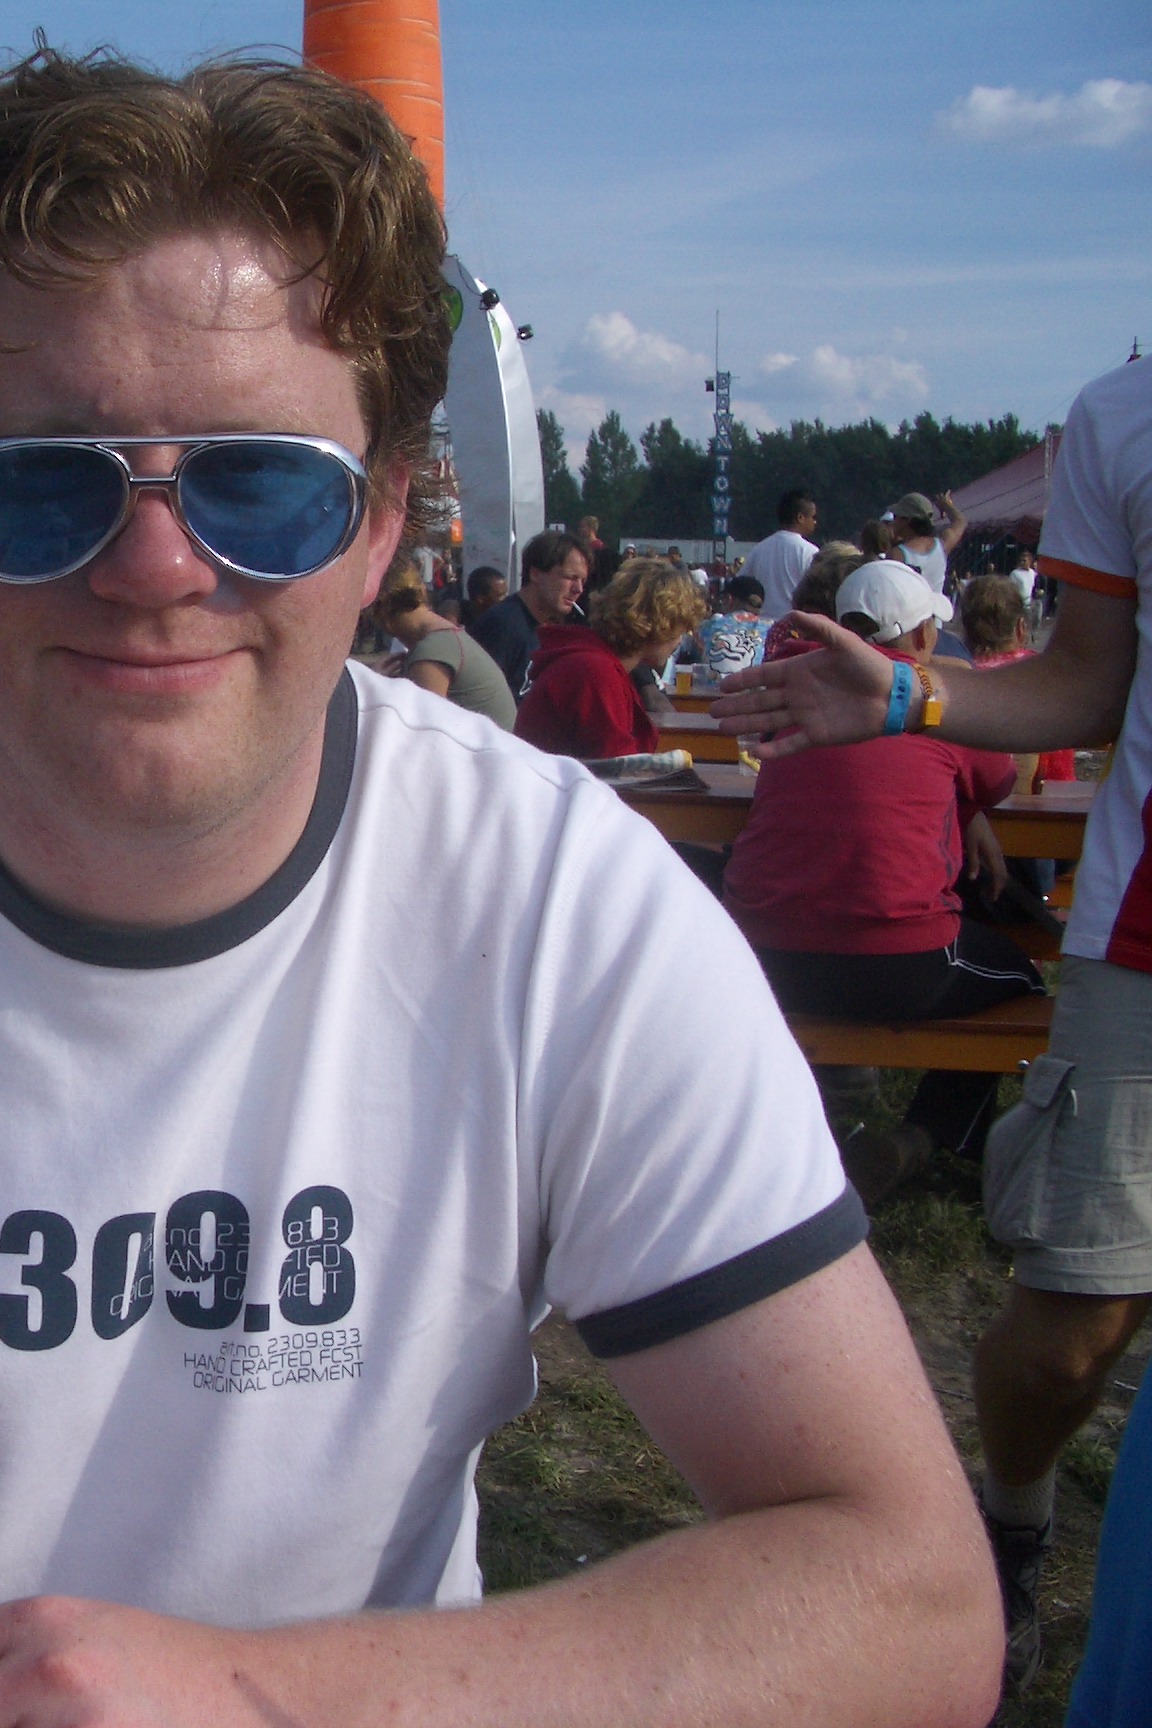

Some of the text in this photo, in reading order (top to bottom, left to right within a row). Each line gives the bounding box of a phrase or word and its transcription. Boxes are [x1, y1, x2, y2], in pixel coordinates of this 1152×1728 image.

[712, 372, 734, 537] DOWNTOWN
[268, 1327, 361, 1355] 2309.833
[184, 1352, 226, 1374] HAND
[230, 1350, 313, 1377] CRAFTED
[193, 1362, 364, 1394] ORIGINAL GARMENT
